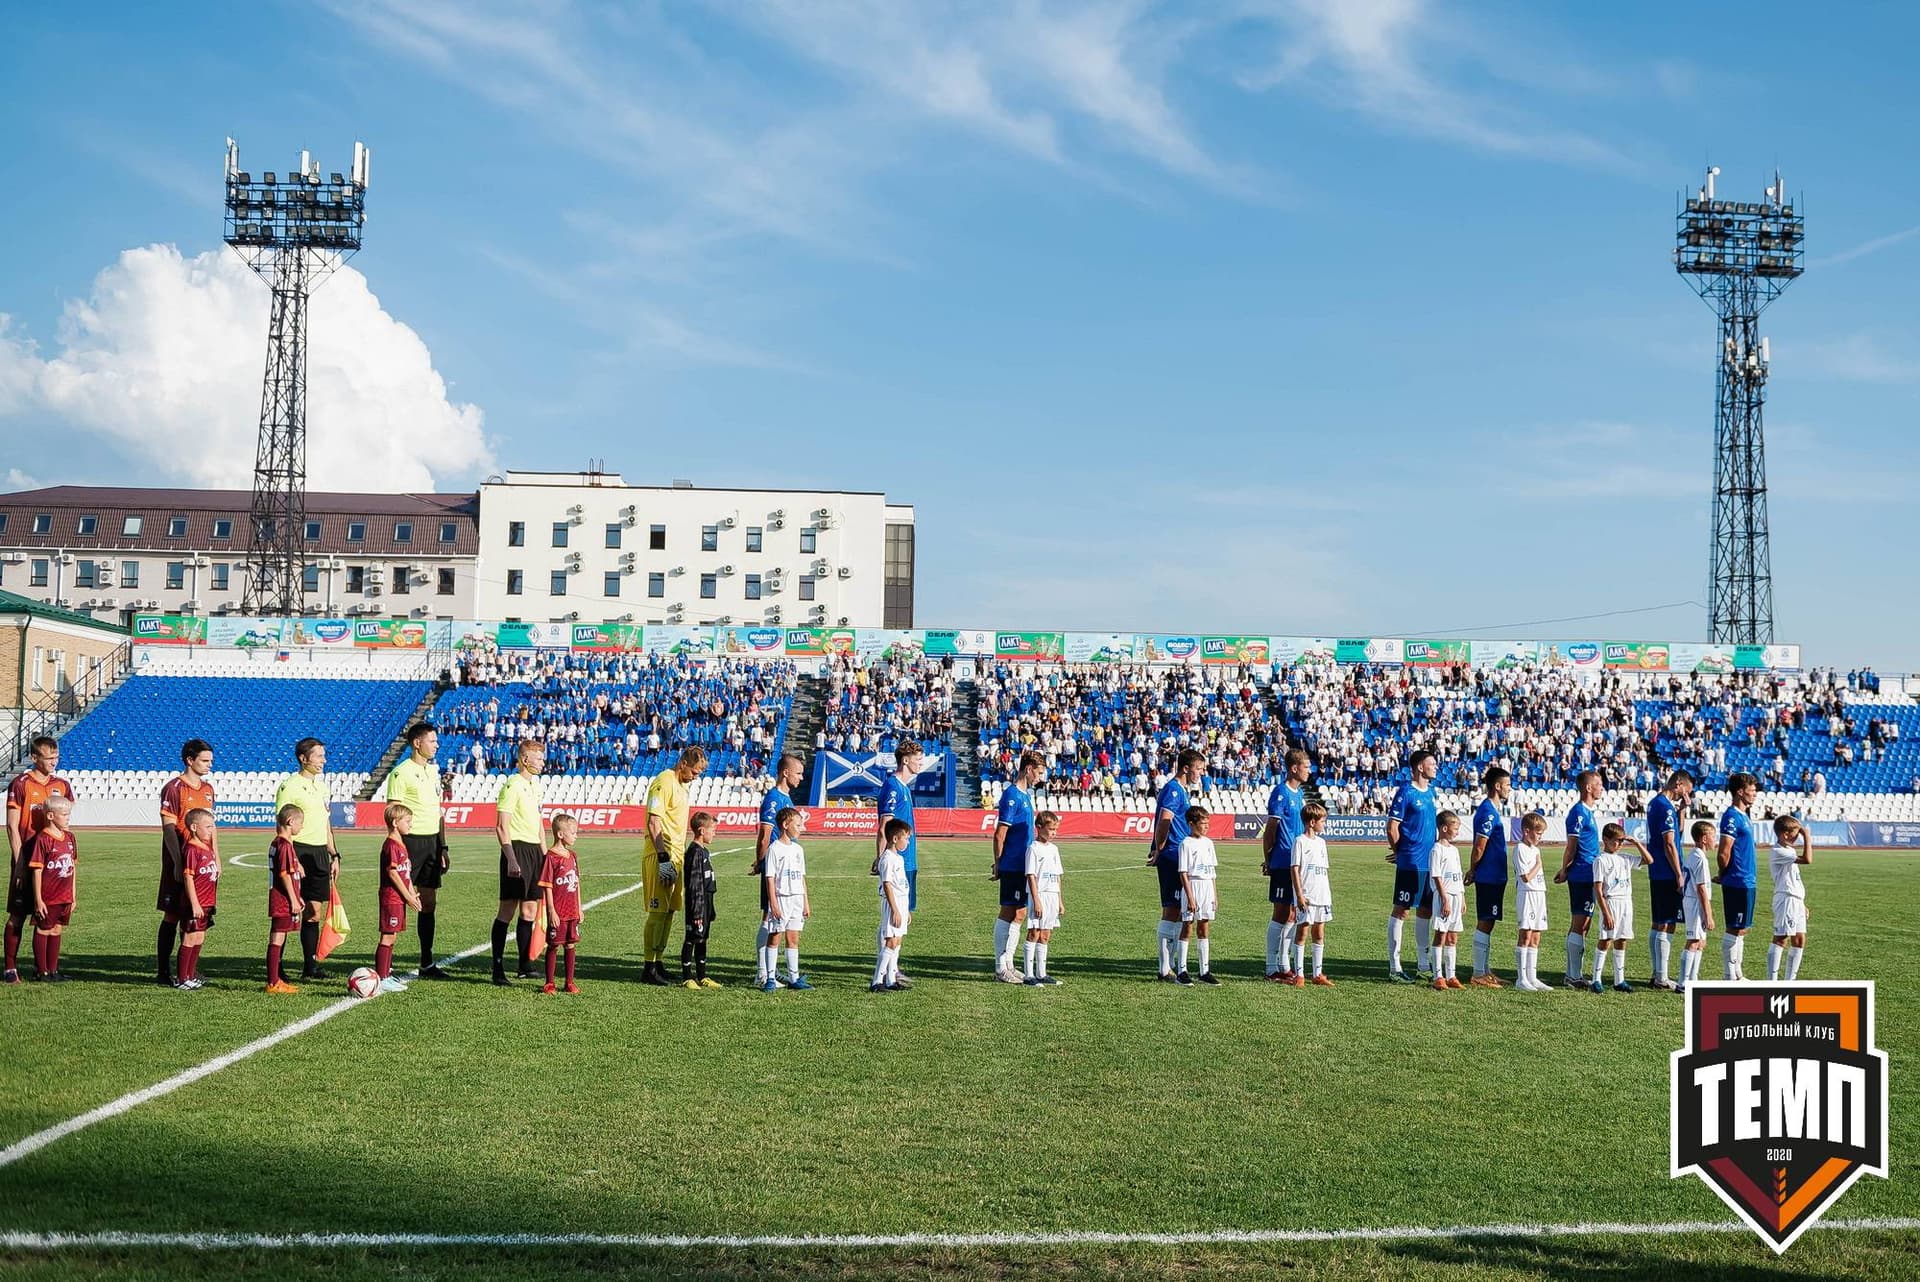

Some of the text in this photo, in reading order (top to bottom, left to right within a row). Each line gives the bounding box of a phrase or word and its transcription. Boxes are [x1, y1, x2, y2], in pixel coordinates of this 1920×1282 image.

[139, 620, 160, 632] ЛАКТ
[359, 624, 379, 635] ЛАКТ
[577, 629, 597, 641] ЛАКТ
[790, 632, 810, 644] ЛАКТ
[1000, 637, 1020, 648] ЛАКТ
[1207, 641, 1226, 652] ЛАКТ
[213, 805, 276, 815] ДМИНИСТРА
[248, 815, 276, 823] БАРН
[1324, 819, 1386, 828] ВИТЕЛЬСТВО
[1316, 828, 1387, 837] АЙСКОГО КРА
[1399, 890, 1410, 902] 30
[1492, 905, 1498, 916] 8
